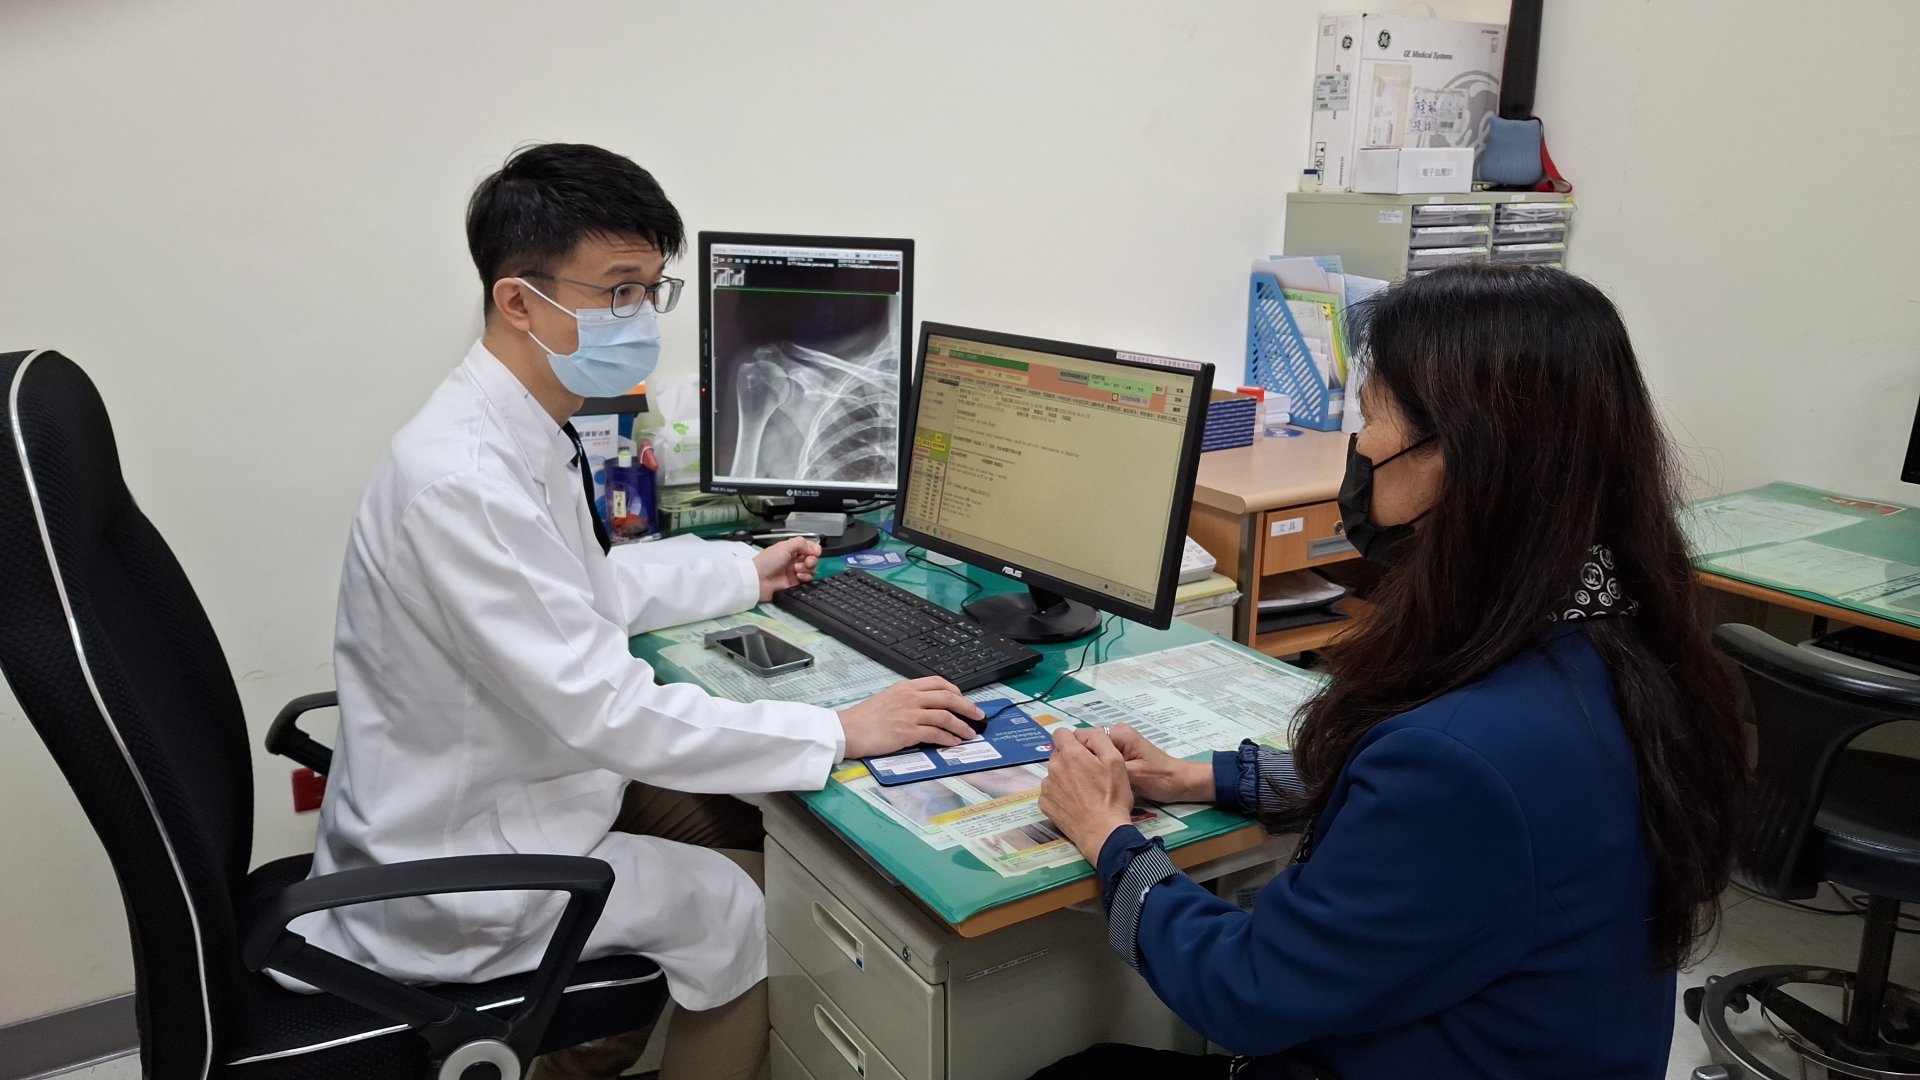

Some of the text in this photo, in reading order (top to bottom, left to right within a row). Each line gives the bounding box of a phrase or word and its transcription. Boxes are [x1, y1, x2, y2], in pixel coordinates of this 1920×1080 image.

[1412, 50, 1432, 59] Medical
[1433, 52, 1453, 60] Systems
[1422, 167, 1454, 177] 電子血壓計
[1001, 566, 1023, 578] ASUS
[995, 727, 1037, 737] Association
